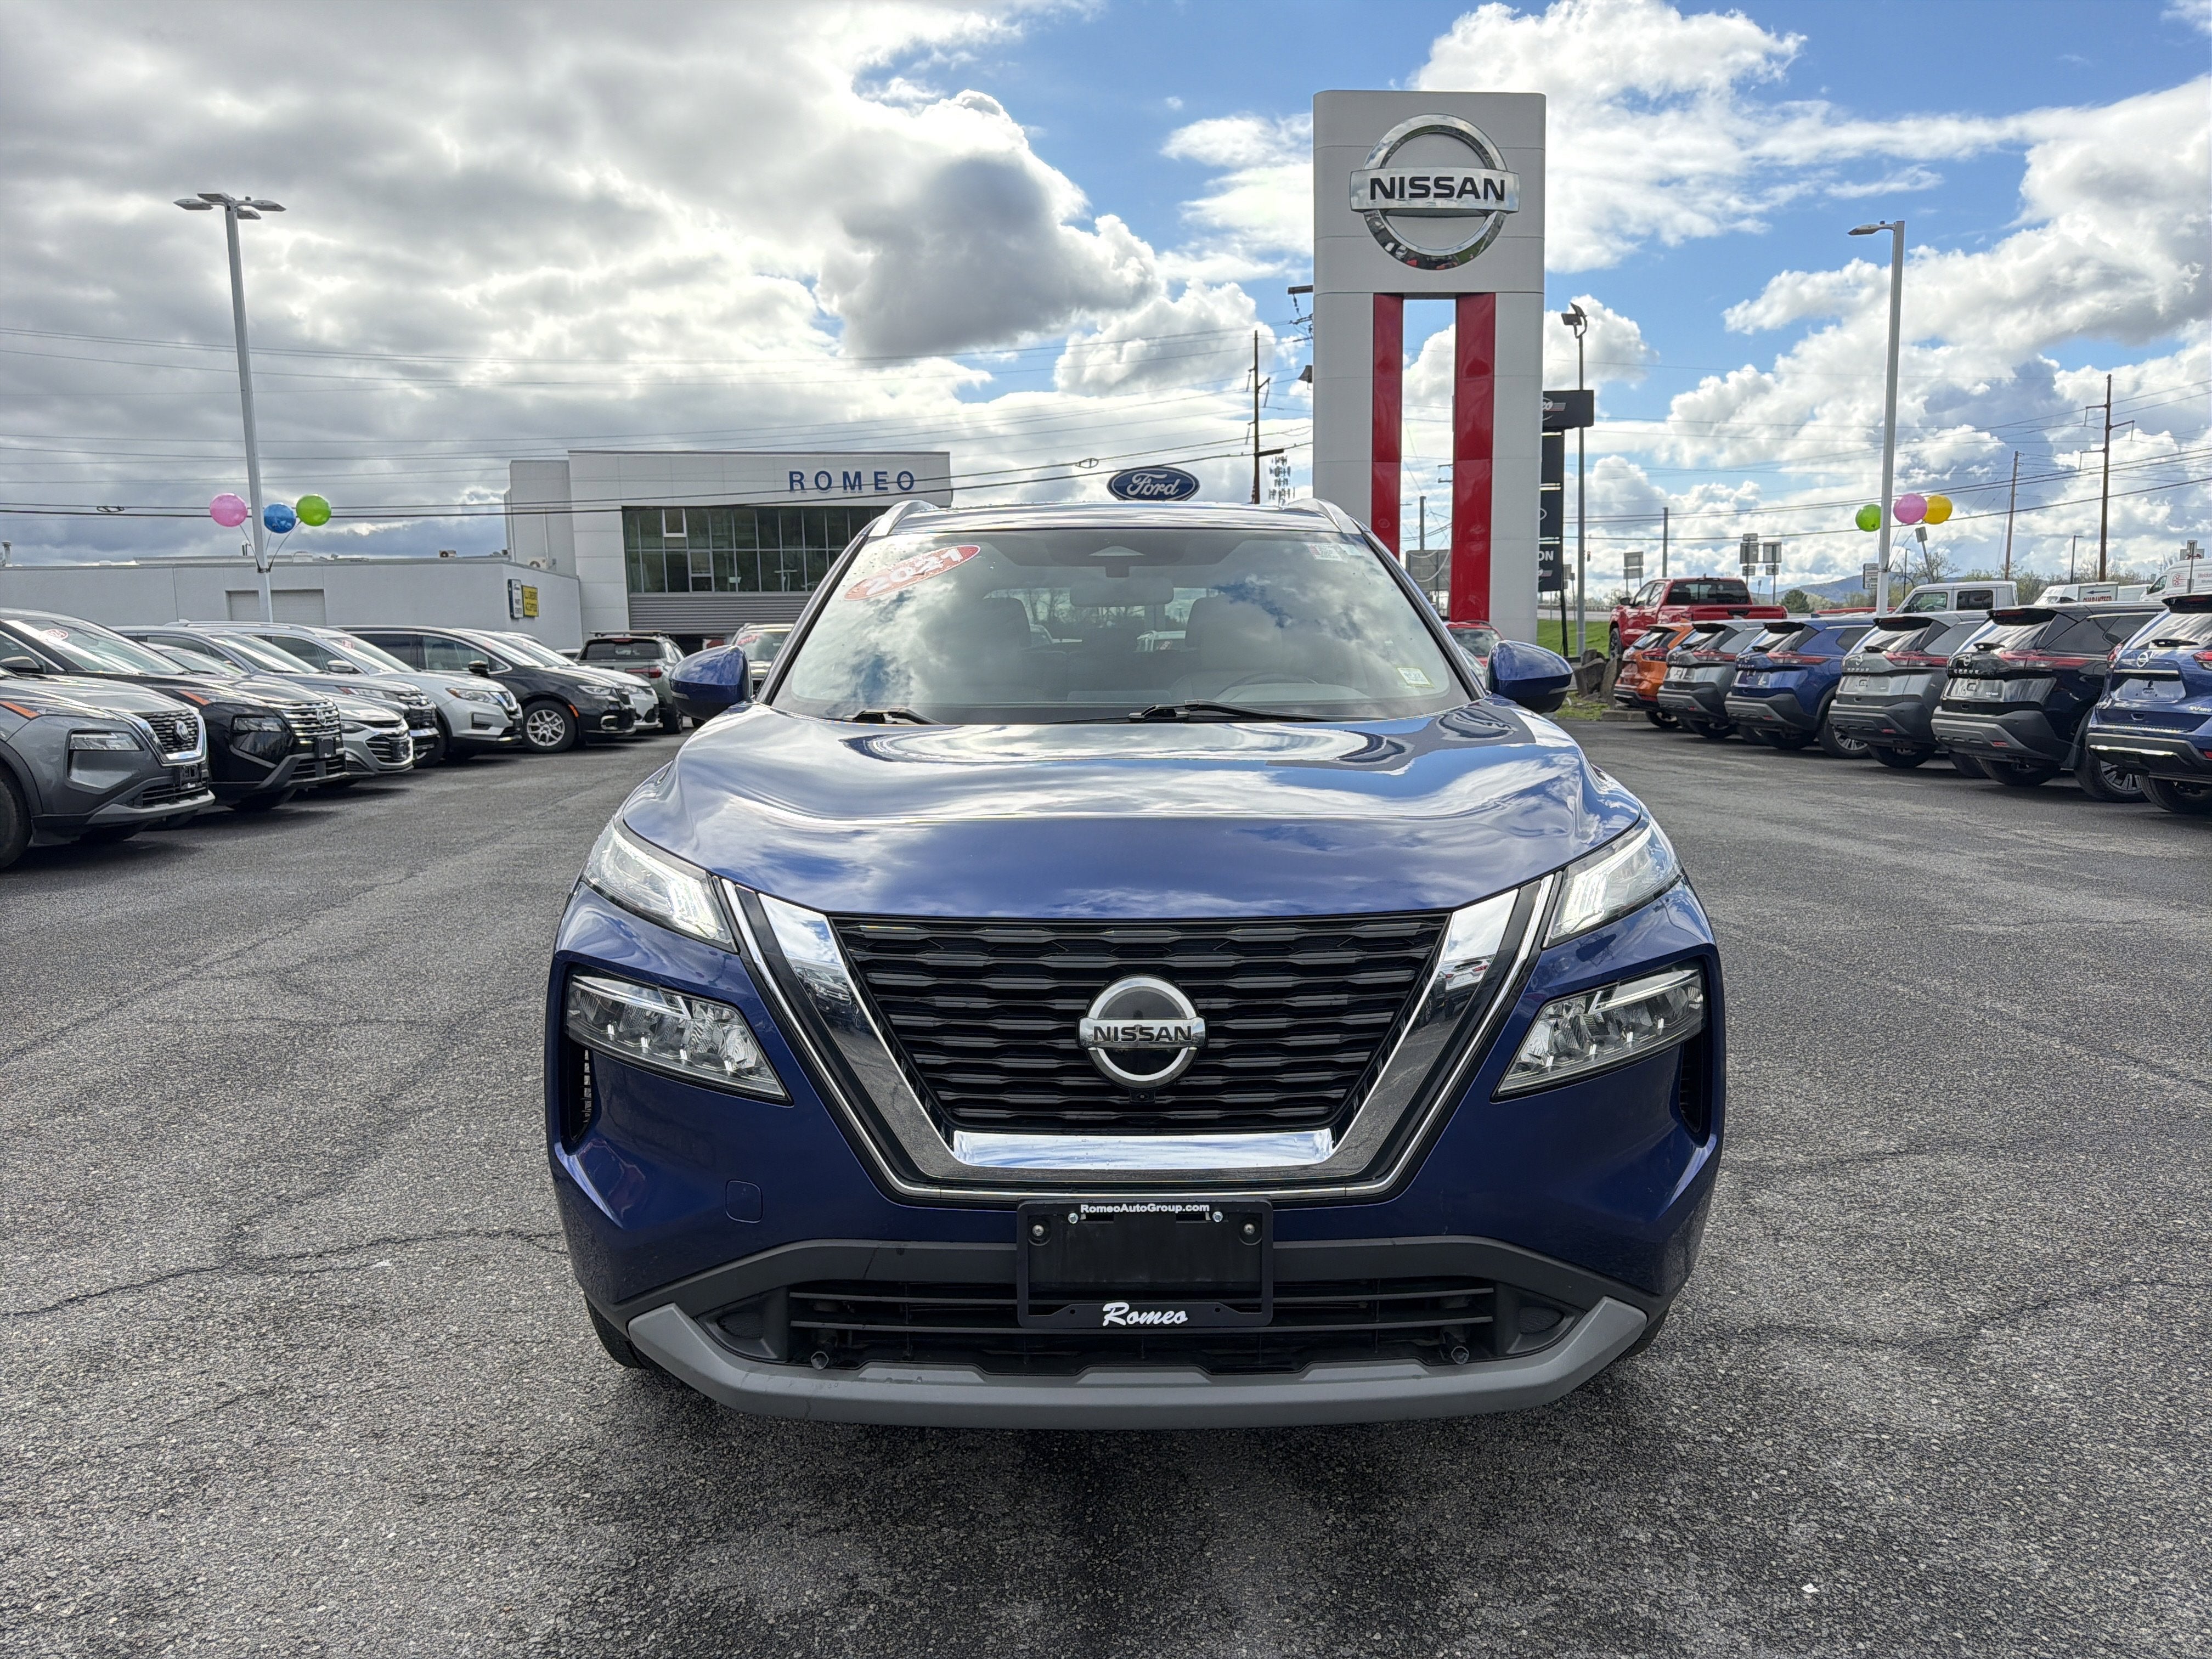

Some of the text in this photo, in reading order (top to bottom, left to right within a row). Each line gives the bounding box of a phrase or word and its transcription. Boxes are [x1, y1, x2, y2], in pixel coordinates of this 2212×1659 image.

[1369, 176, 1506, 201] NISSAN
[788, 470, 916, 494] ROMEO
[1126, 472, 1181, 496] Ford
[1093, 1025, 1192, 1042] NISSAN
[1080, 1204, 1210, 1214] RomeoAutoGroup.com
[1103, 1302, 1188, 1326] Romeo
